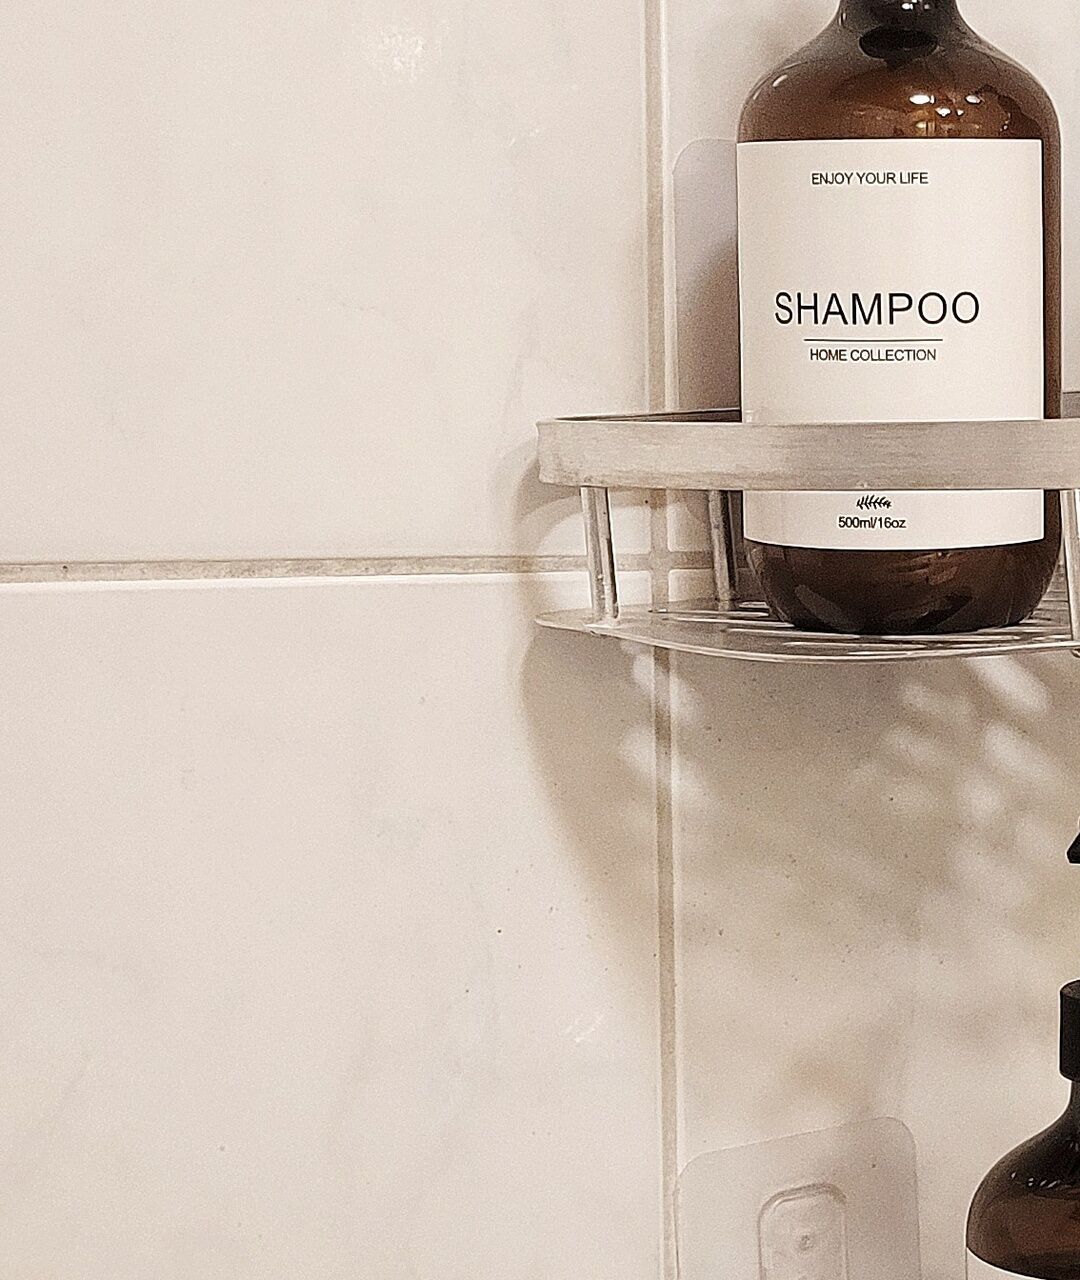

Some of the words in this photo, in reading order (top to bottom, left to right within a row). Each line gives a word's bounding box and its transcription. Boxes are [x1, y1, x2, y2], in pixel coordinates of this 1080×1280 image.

[811, 172, 854, 186] ENJOY
[855, 172, 897, 186] YOUR
[899, 172, 929, 185] LIFE
[774, 291, 980, 326] SHAMPOO
[810, 348, 848, 362] HOME
[850, 348, 937, 362] COLLECTION
[838, 516, 907, 529] 500ml/16oz
